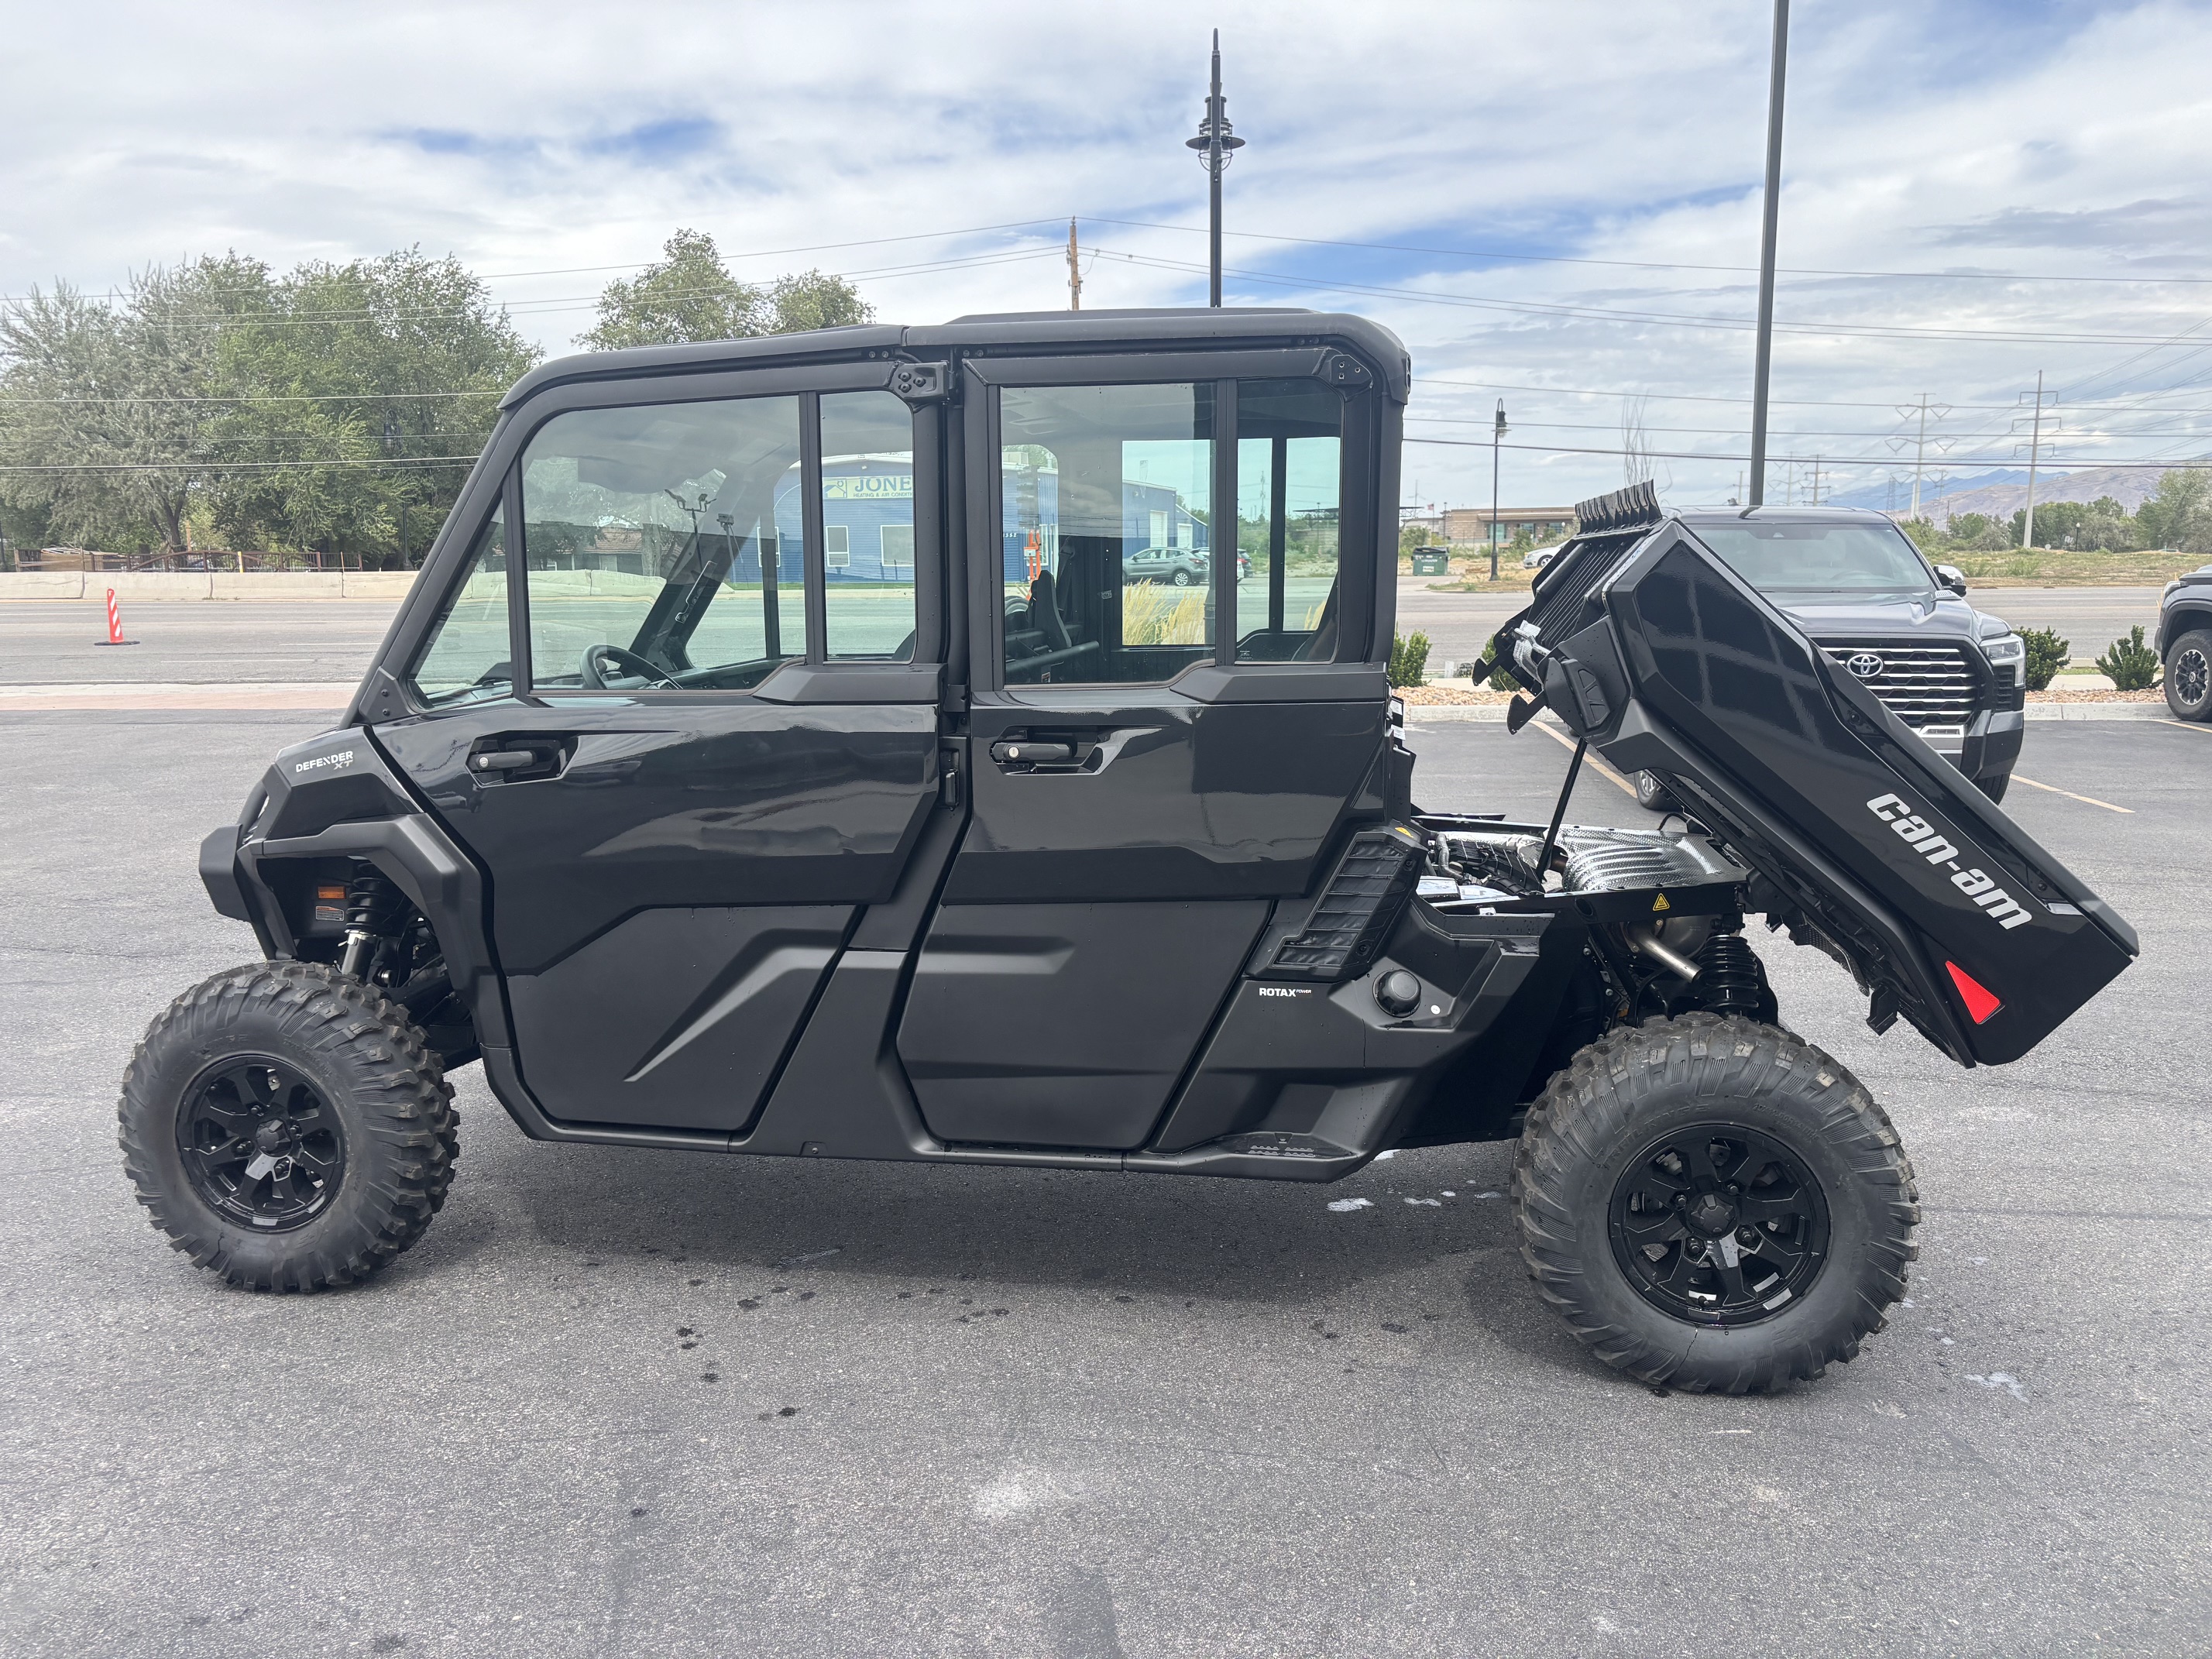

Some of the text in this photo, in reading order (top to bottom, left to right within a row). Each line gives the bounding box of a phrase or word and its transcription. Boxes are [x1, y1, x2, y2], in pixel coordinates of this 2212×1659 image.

[295, 750, 354, 773] DEFENDER
[333, 759, 354, 770] XT
[1866, 793, 2033, 930] can-am
[1259, 988, 1297, 997] ROTAX
